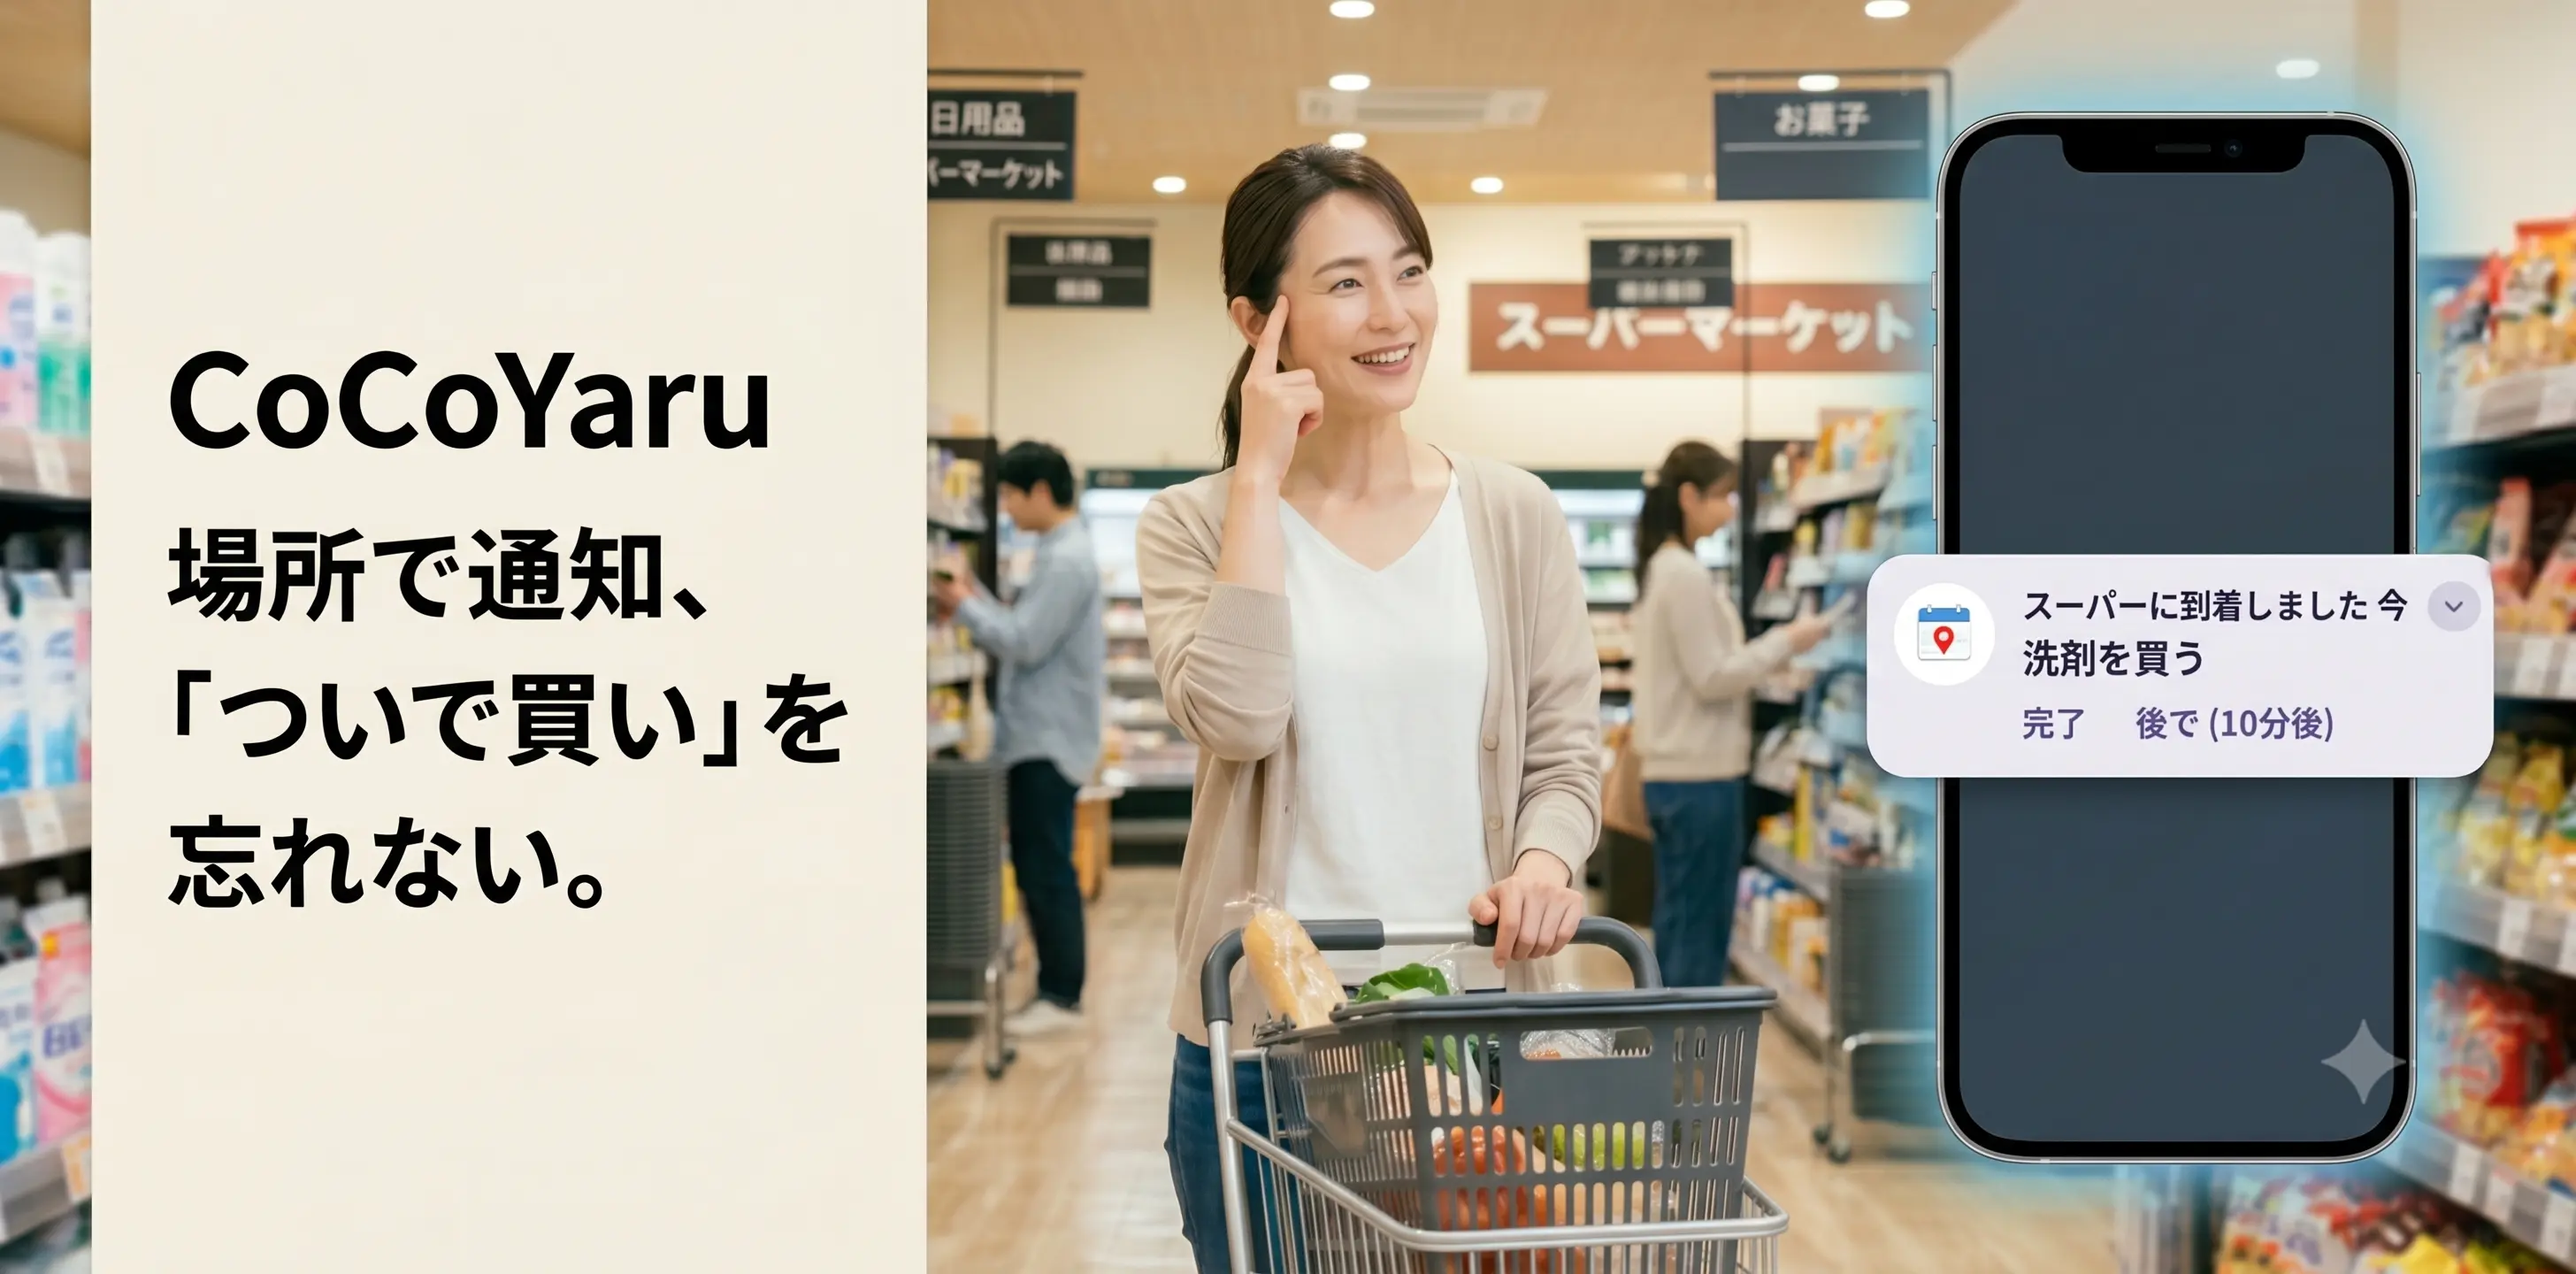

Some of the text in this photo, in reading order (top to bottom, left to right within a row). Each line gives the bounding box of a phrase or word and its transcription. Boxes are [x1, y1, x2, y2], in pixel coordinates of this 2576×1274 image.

[931, 101, 1025, 136] 日用品
[2023, 587, 2409, 623] スーパーに到着しました 今
[2021, 638, 2204, 679] 洗剤を買う
[2021, 705, 2085, 741] 完了
[2135, 705, 2334, 744] 後で (10分後)
